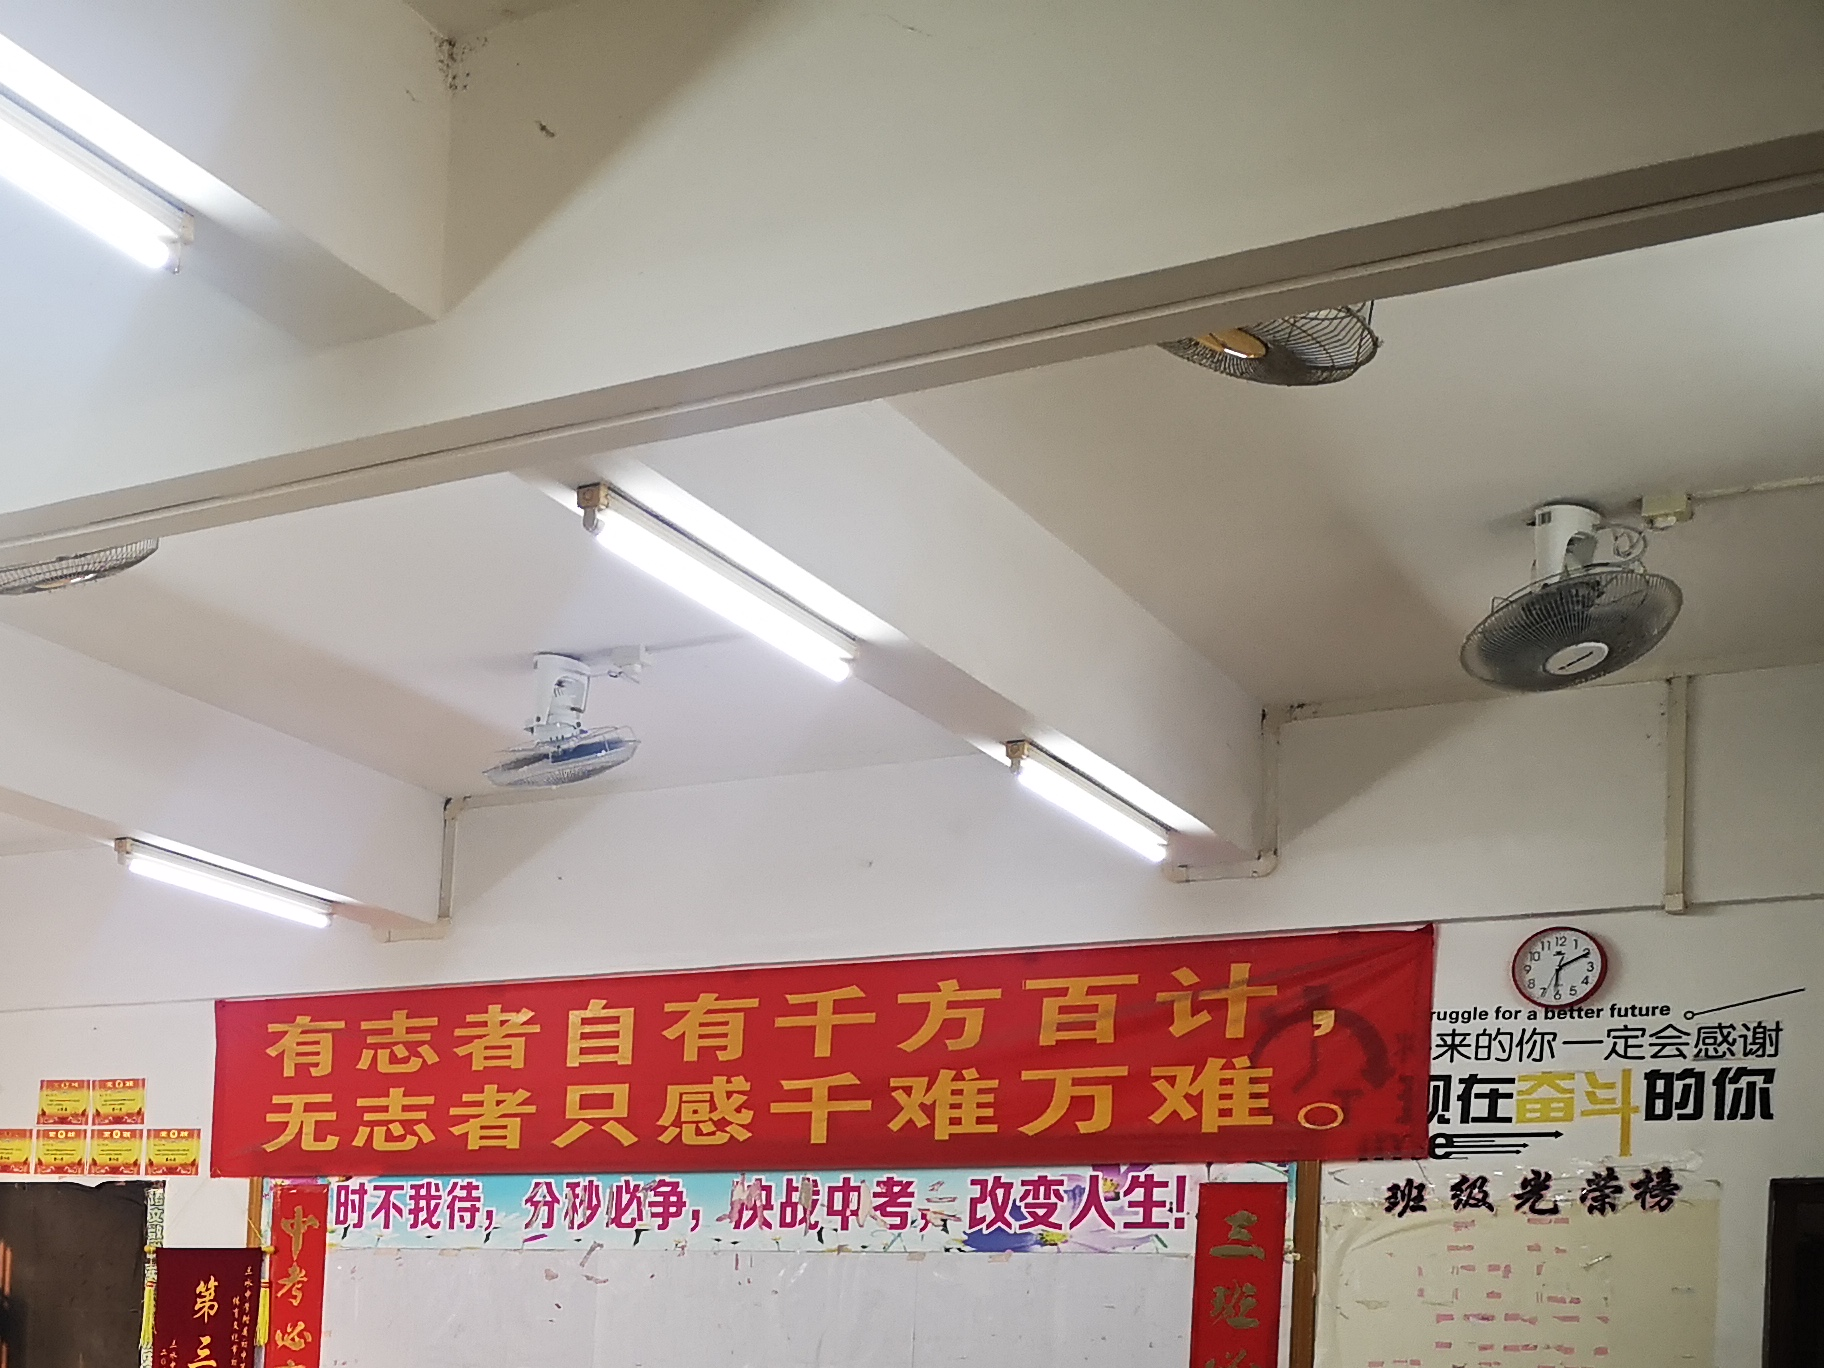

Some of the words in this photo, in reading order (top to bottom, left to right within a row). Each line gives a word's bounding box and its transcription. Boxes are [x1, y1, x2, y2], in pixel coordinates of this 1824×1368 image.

[266, 963, 1336, 1077] 有志者自有千方百计，
[1494, 1006, 1522, 1021] for
[1526, 1008, 1538, 1021] a
[1543, 1004, 1604, 1021] better
[1609, 1003, 1671, 1018] future
[1429, 1019, 1783, 1063] 来的你一定会感谢
[263, 1056, 1344, 1152] 无志者只感千难万难。
[1384, 1166, 1683, 1217] 班级光荣榜
